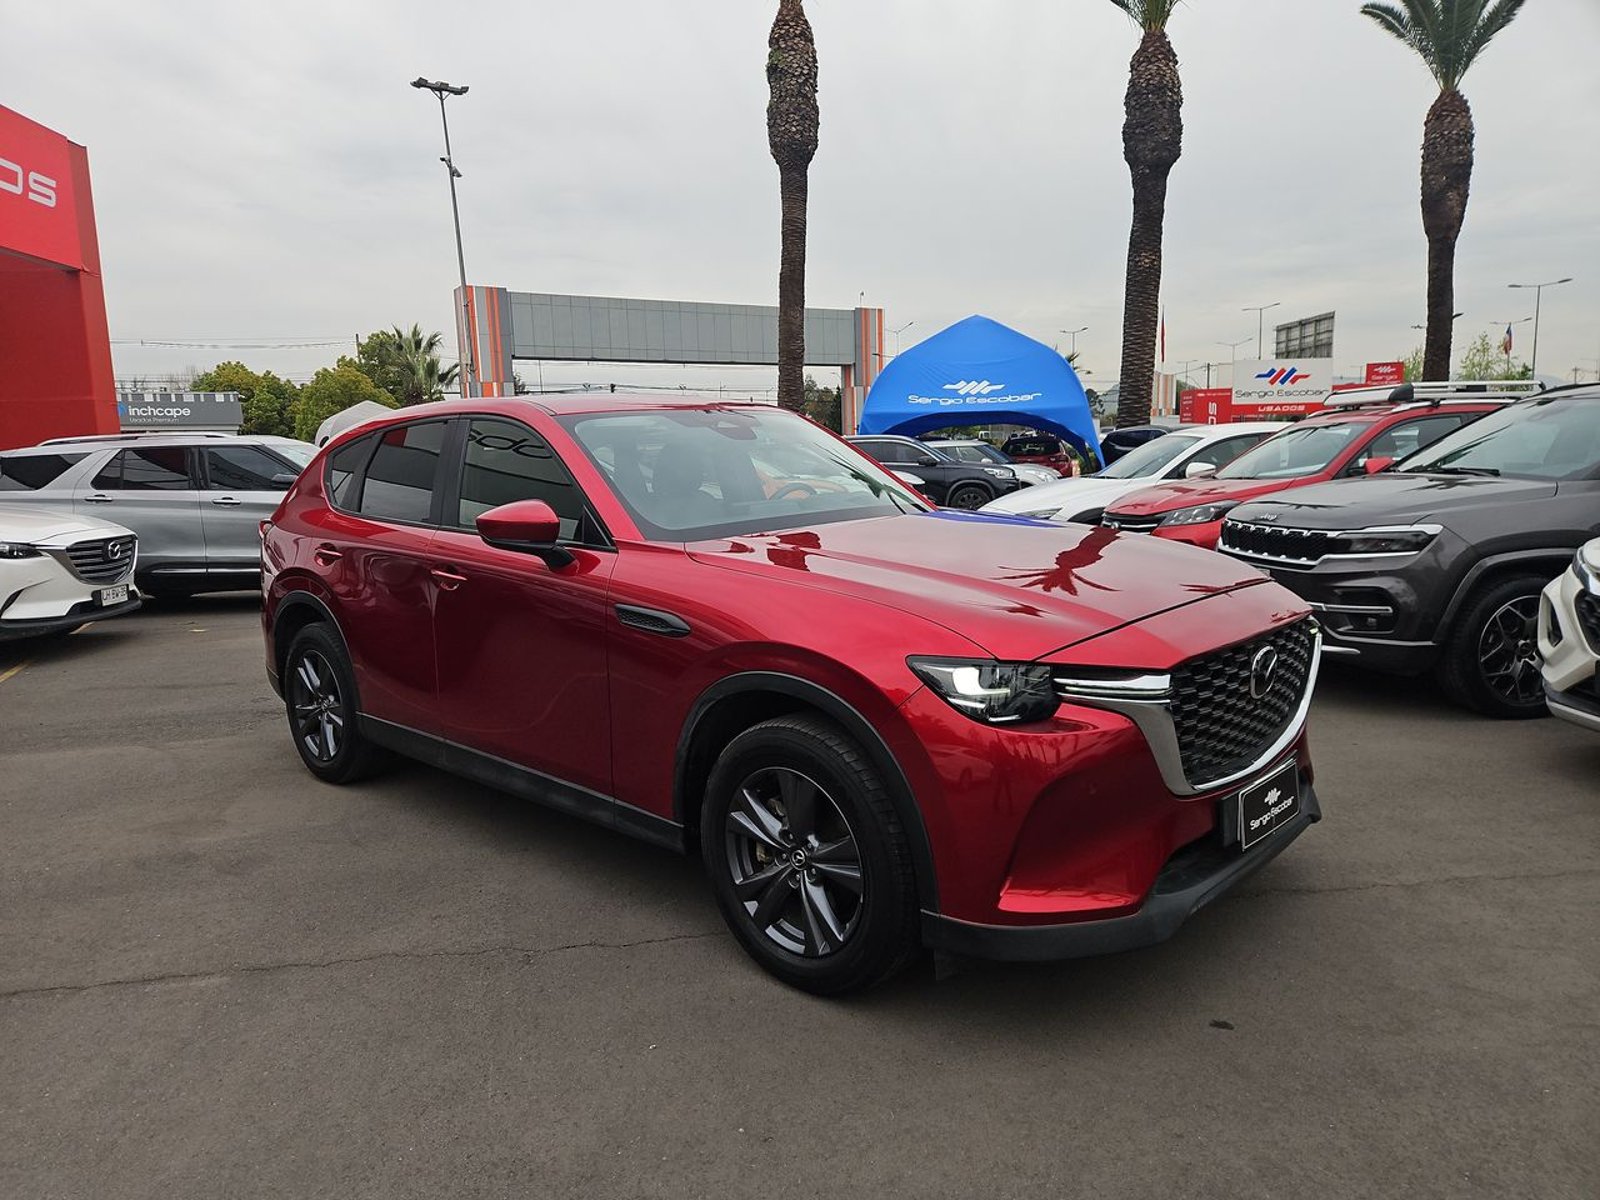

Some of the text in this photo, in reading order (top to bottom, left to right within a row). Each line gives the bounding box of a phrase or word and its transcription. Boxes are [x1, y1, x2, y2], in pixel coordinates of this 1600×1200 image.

[965, 392, 1042, 404] Escobar
[1277, 388, 1330, 397] Escobar
[128, 405, 191, 418] inchcape
